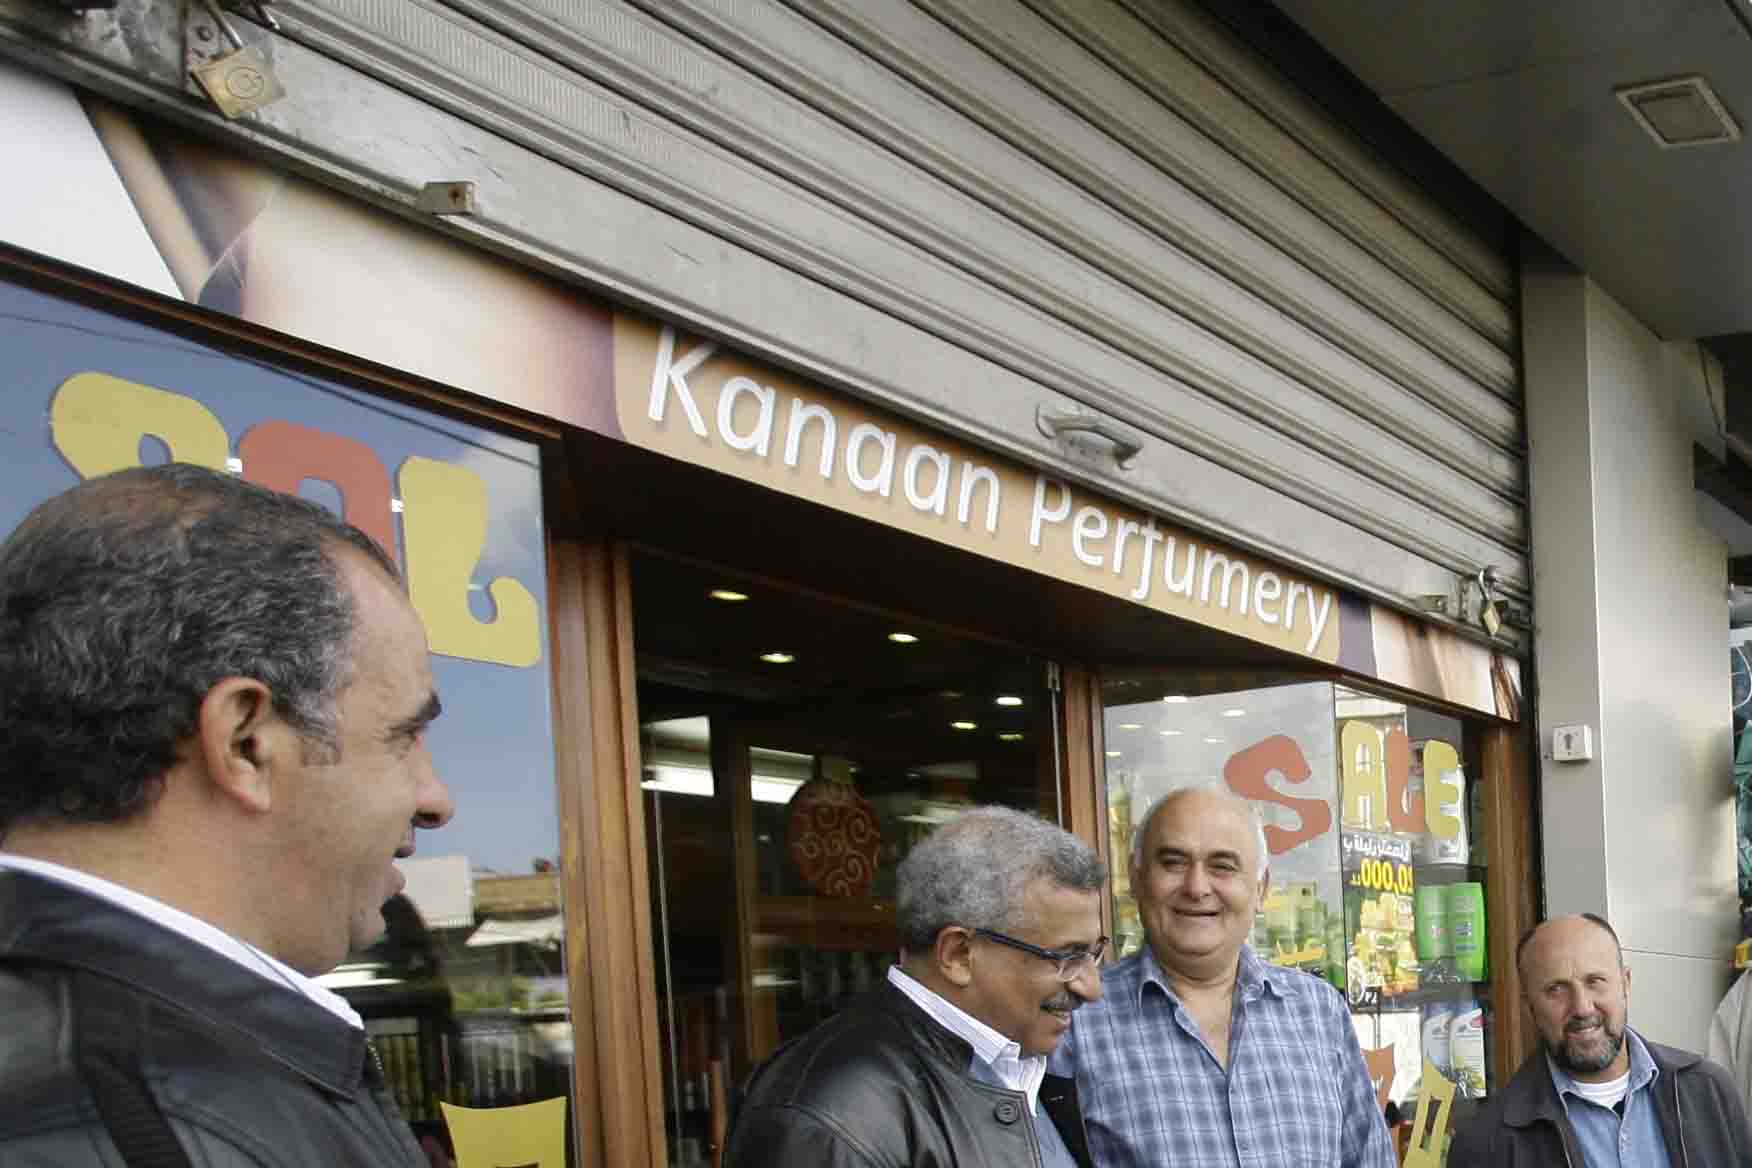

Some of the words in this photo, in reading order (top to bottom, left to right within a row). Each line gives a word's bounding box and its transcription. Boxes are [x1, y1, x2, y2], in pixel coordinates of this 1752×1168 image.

[645, 322, 999, 532] Kanaan
[1030, 474, 1333, 653] Perfumery
[1224, 718, 1464, 856] SALE
